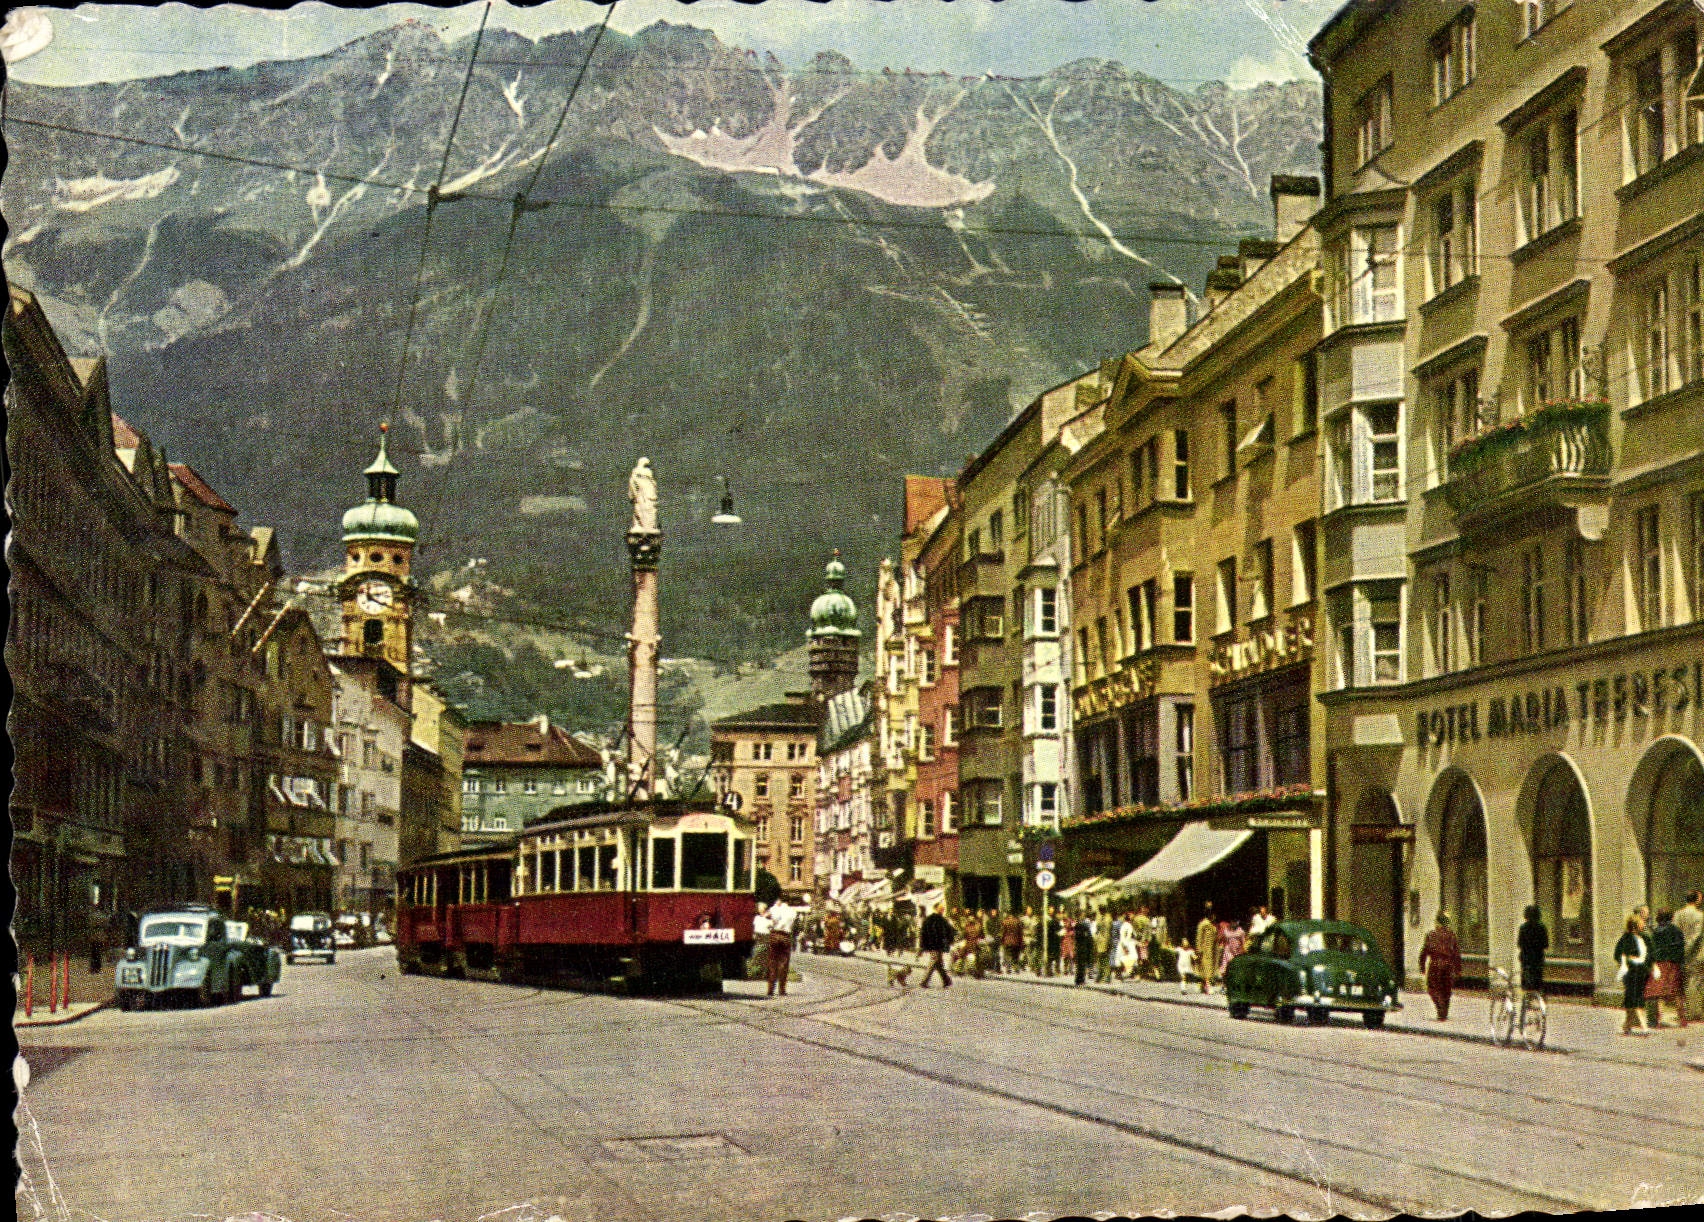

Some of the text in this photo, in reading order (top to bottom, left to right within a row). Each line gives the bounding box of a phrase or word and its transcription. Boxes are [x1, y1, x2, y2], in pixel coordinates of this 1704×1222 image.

[1416, 700, 1482, 748] HOTEL
[1487, 686, 1569, 737] MARIA
[725, 792, 738, 811] 4
